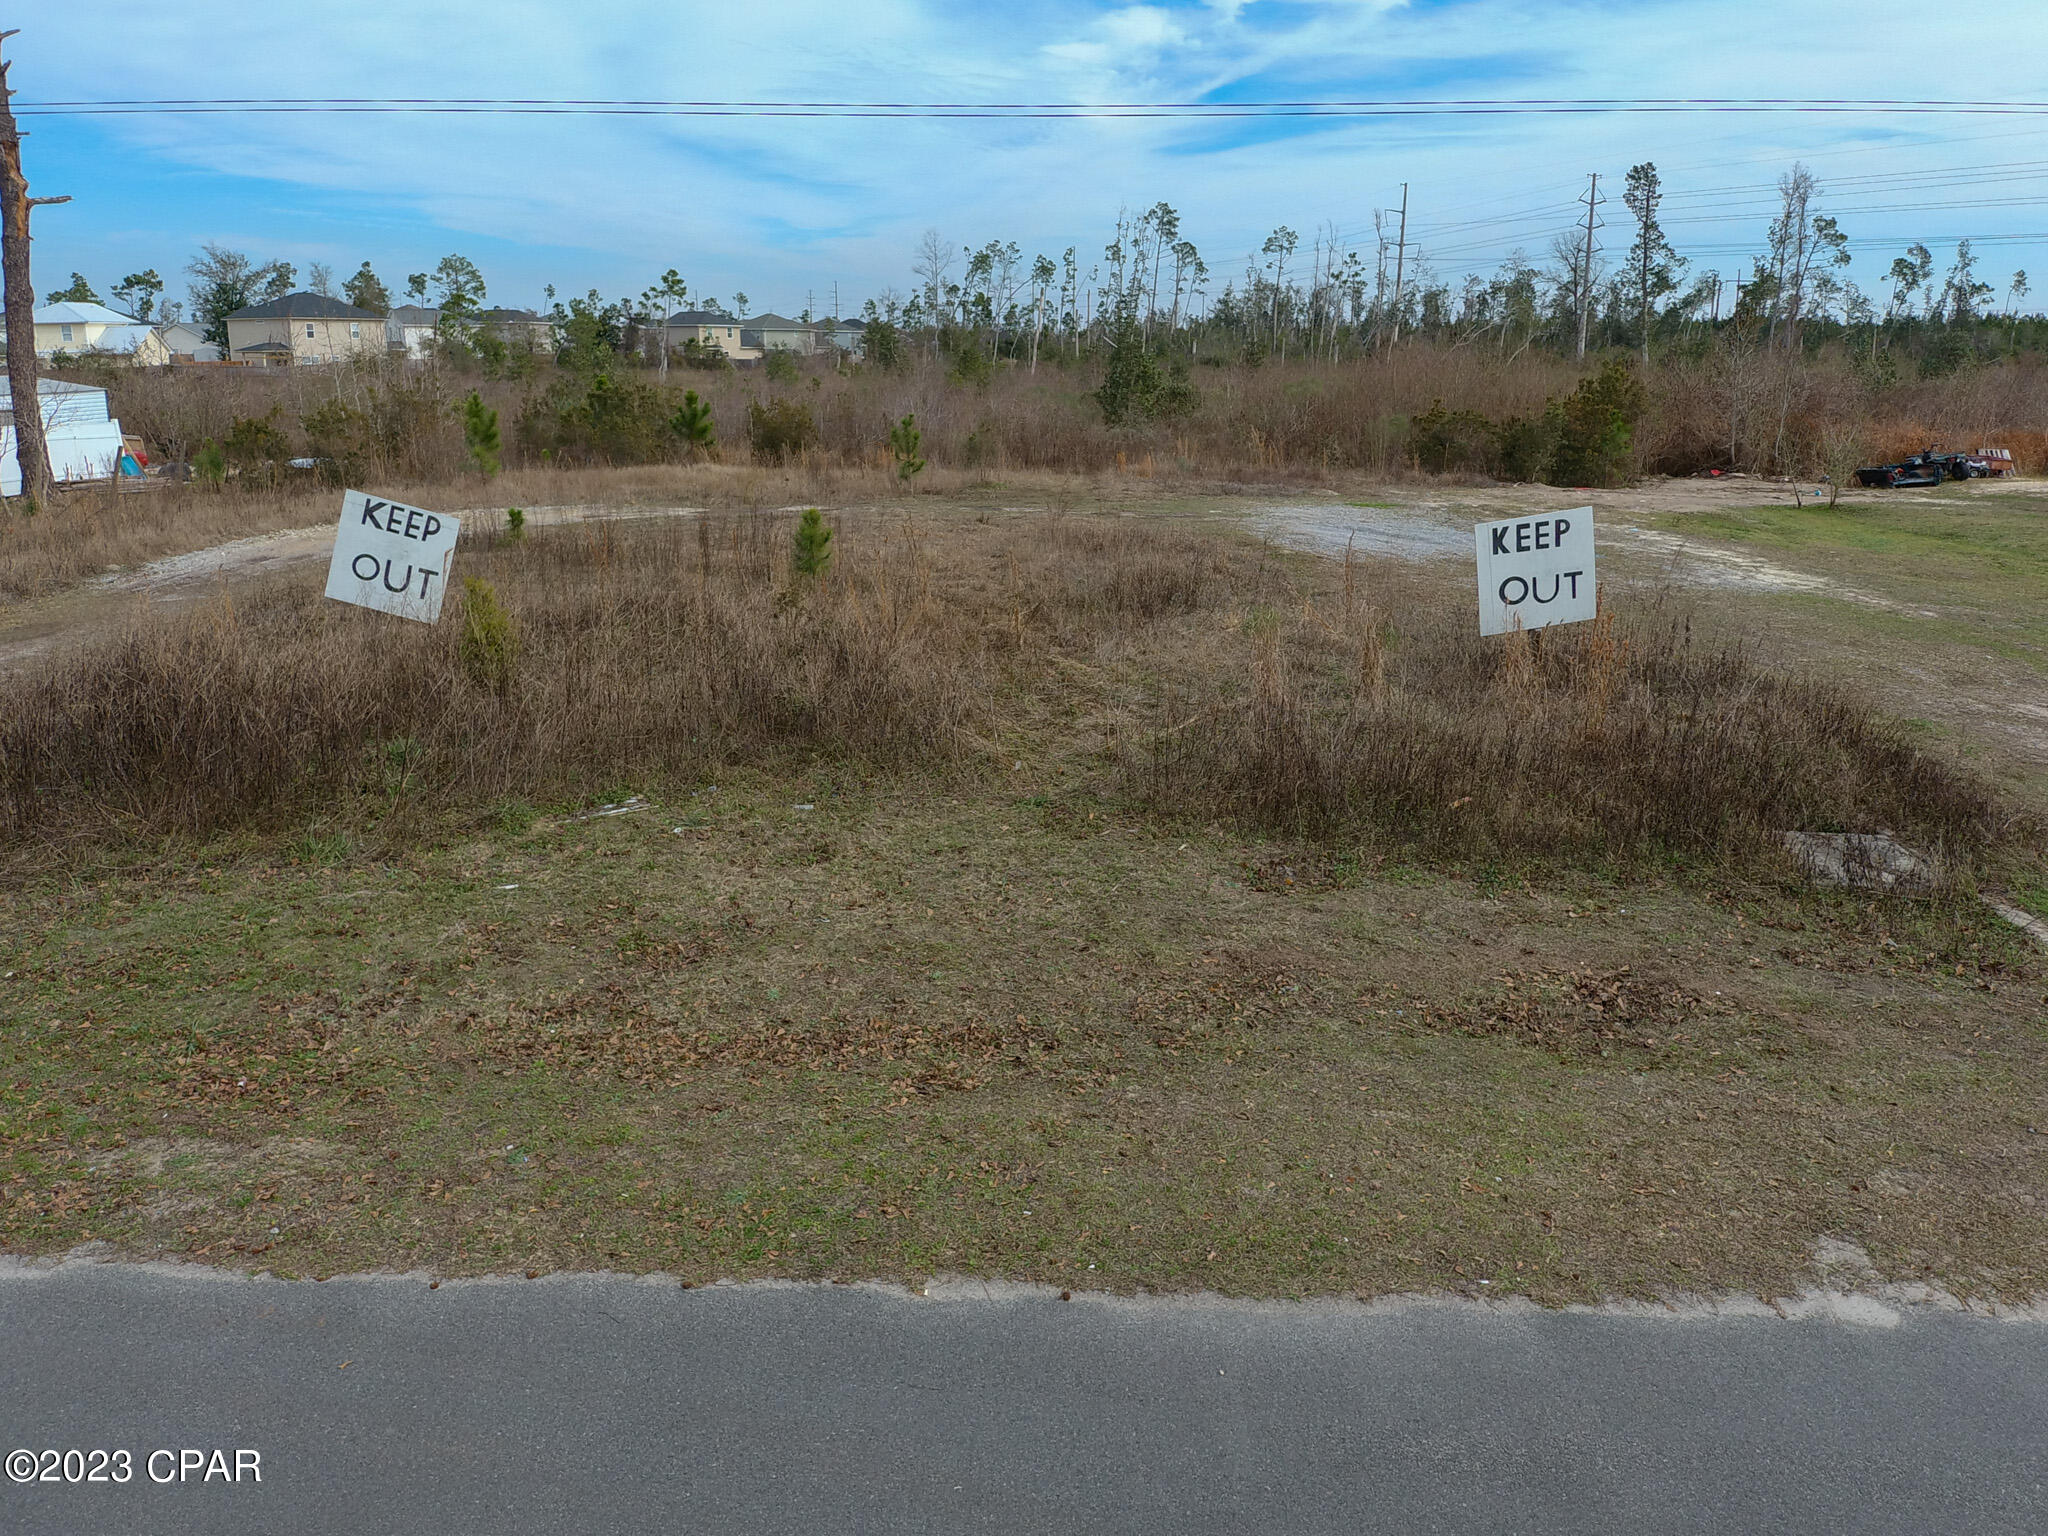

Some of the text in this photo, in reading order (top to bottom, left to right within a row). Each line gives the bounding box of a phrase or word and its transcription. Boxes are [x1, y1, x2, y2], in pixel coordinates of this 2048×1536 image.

[361, 498, 441, 542] KEEP
[1492, 519, 1571, 555] KEEP
[352, 554, 439, 599] OUT
[1498, 571, 1583, 605] OUT
